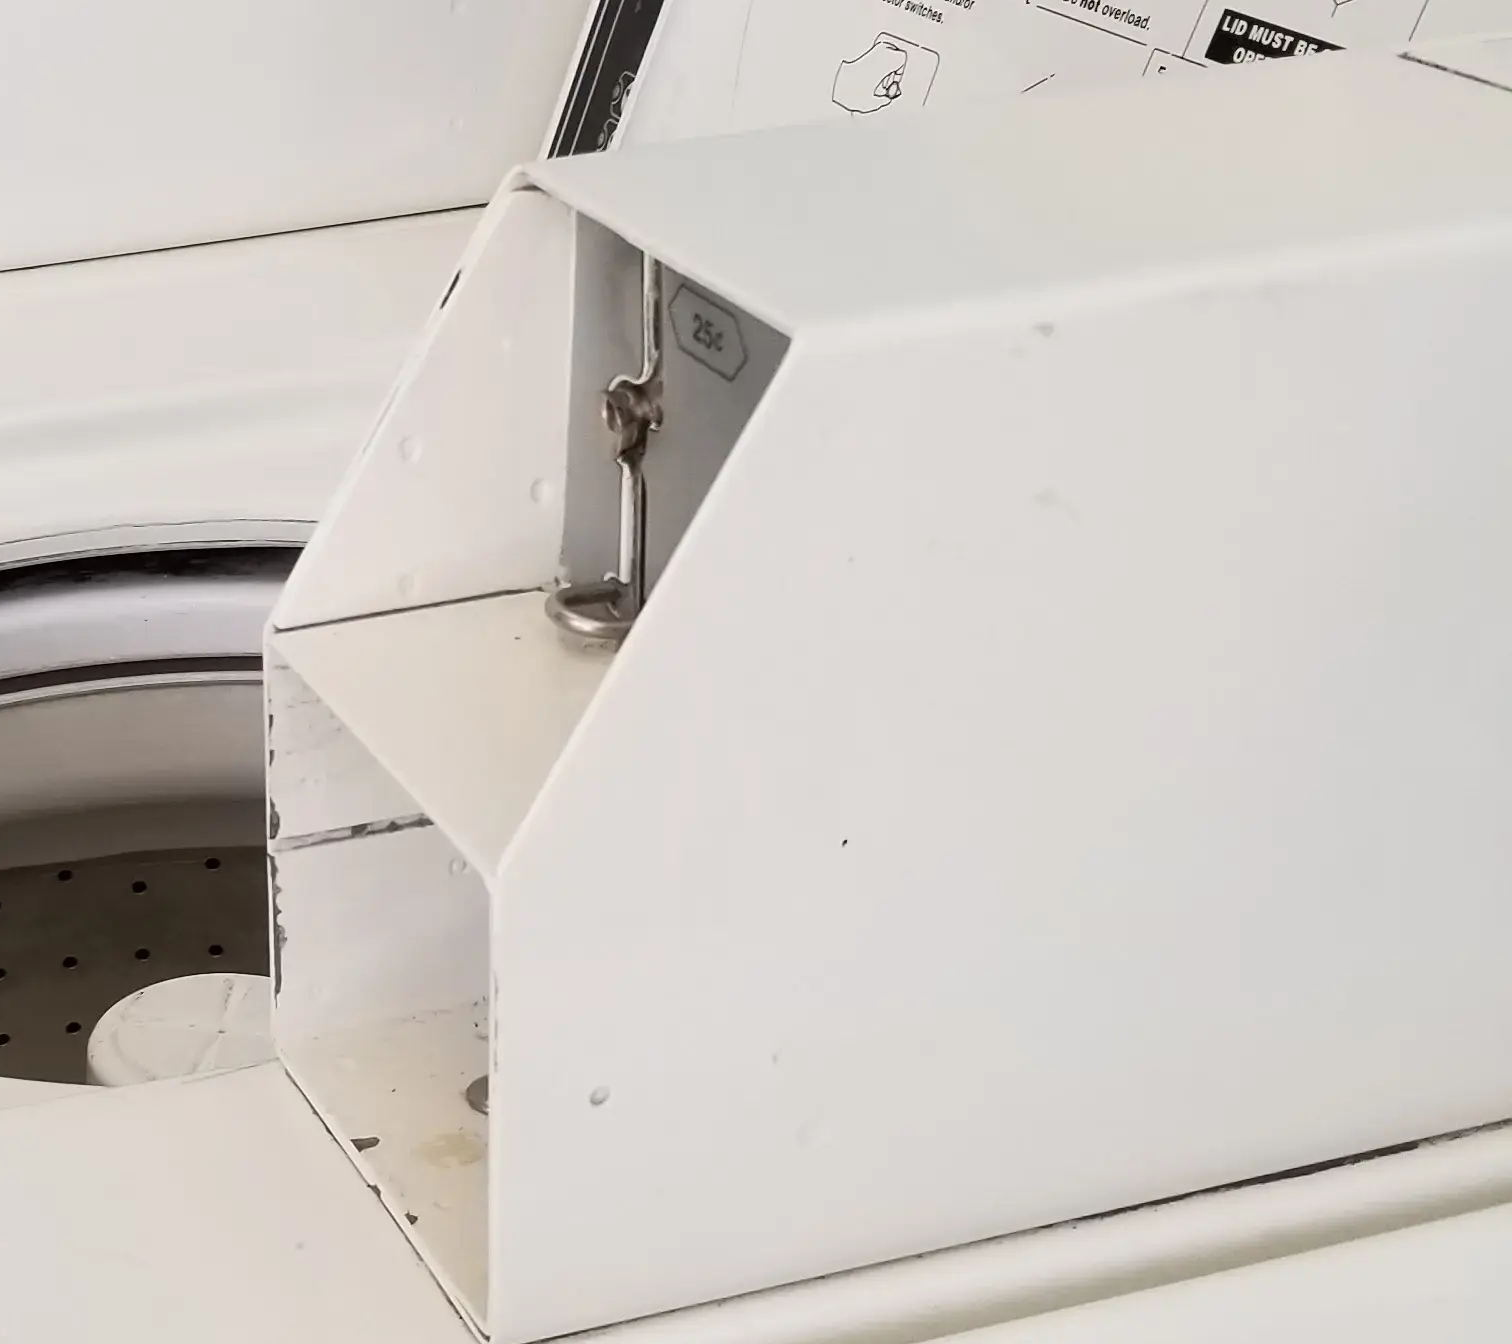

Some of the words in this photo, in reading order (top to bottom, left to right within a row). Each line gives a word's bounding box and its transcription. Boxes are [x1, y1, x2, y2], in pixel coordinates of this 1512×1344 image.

[905, 0, 944, 24] switches.
[1102, 5, 1150, 31] overload.
[1222, 16, 1248, 35] LID
[1248, 25, 1294, 51] MUST
[693, 313, 723, 352] 25¢
